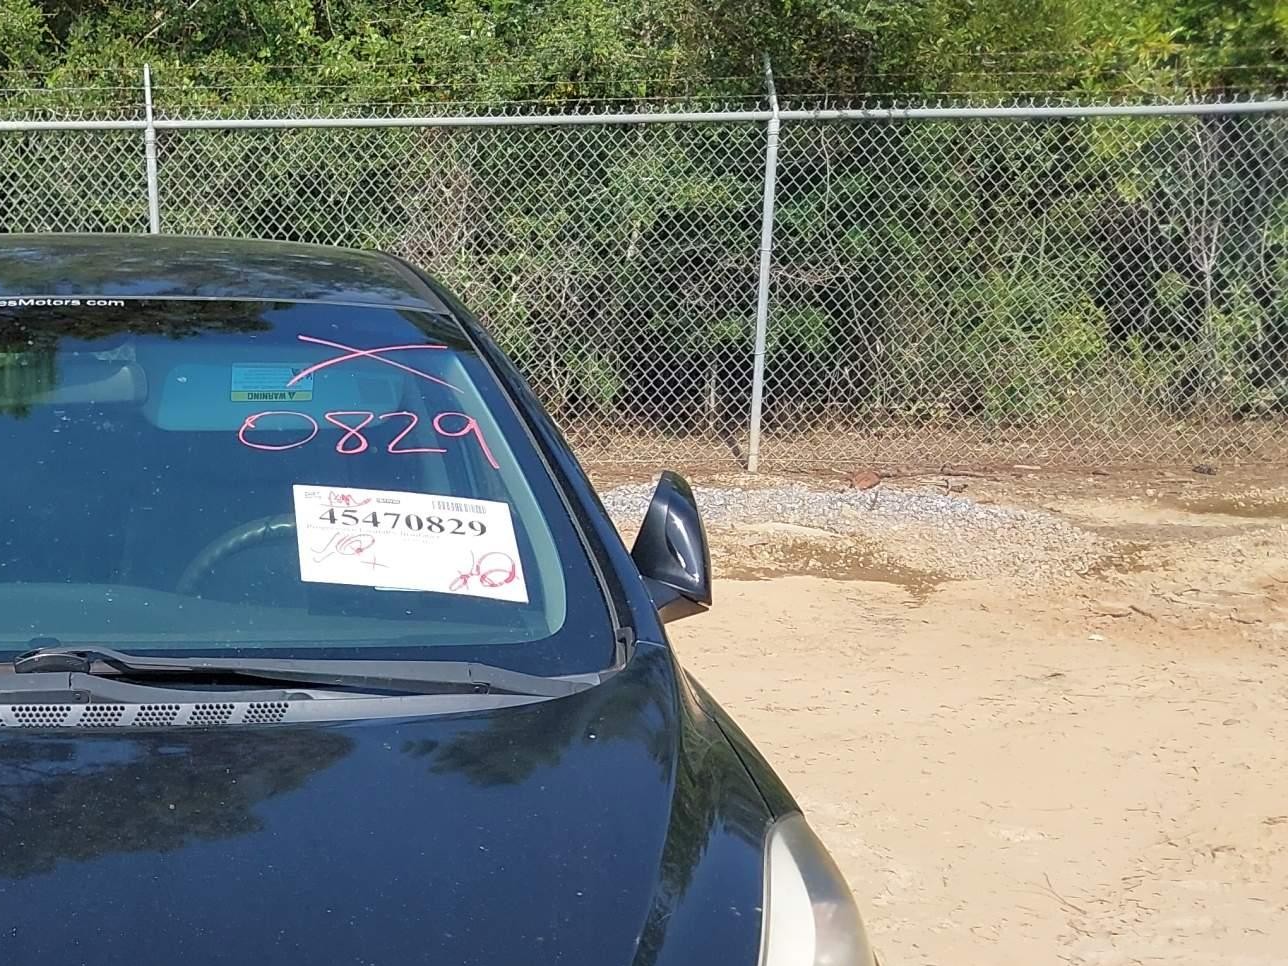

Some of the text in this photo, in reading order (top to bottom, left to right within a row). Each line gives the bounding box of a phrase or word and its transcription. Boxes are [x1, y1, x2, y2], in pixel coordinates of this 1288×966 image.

[247, 391, 287, 401] WARNING
[238, 411, 500, 469] 0829
[319, 507, 488, 537] 45470829
